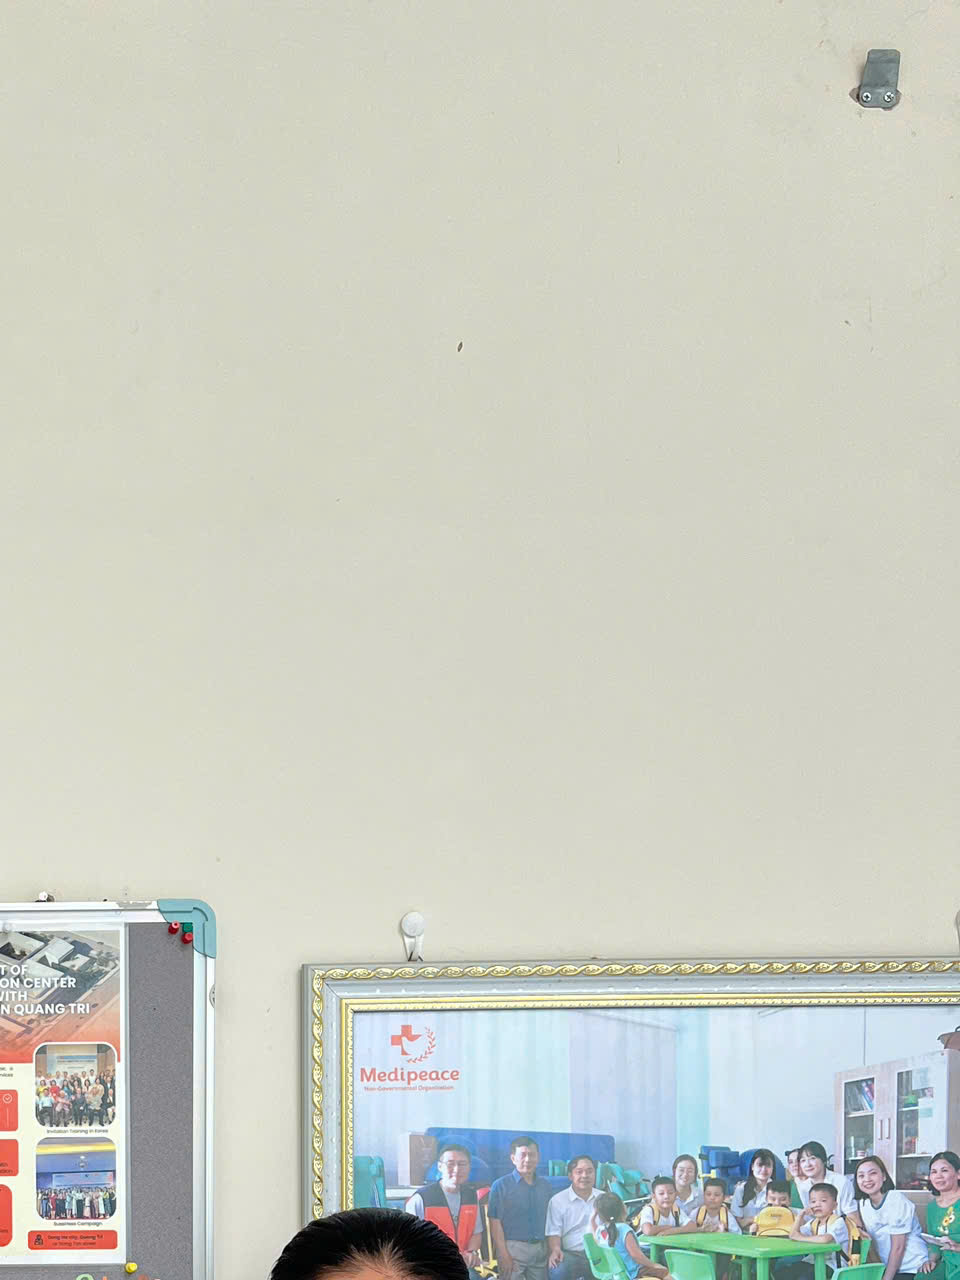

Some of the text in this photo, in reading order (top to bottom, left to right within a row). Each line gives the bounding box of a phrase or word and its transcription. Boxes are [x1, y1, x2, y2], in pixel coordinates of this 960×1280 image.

[10, 965, 28, 975] OF
[23, 977, 76, 988] CENTER
[14, 1003, 65, 1015] QUANG
[69, 1003, 90, 1014] TRI
[360, 1067, 460, 1085] Medipeace
